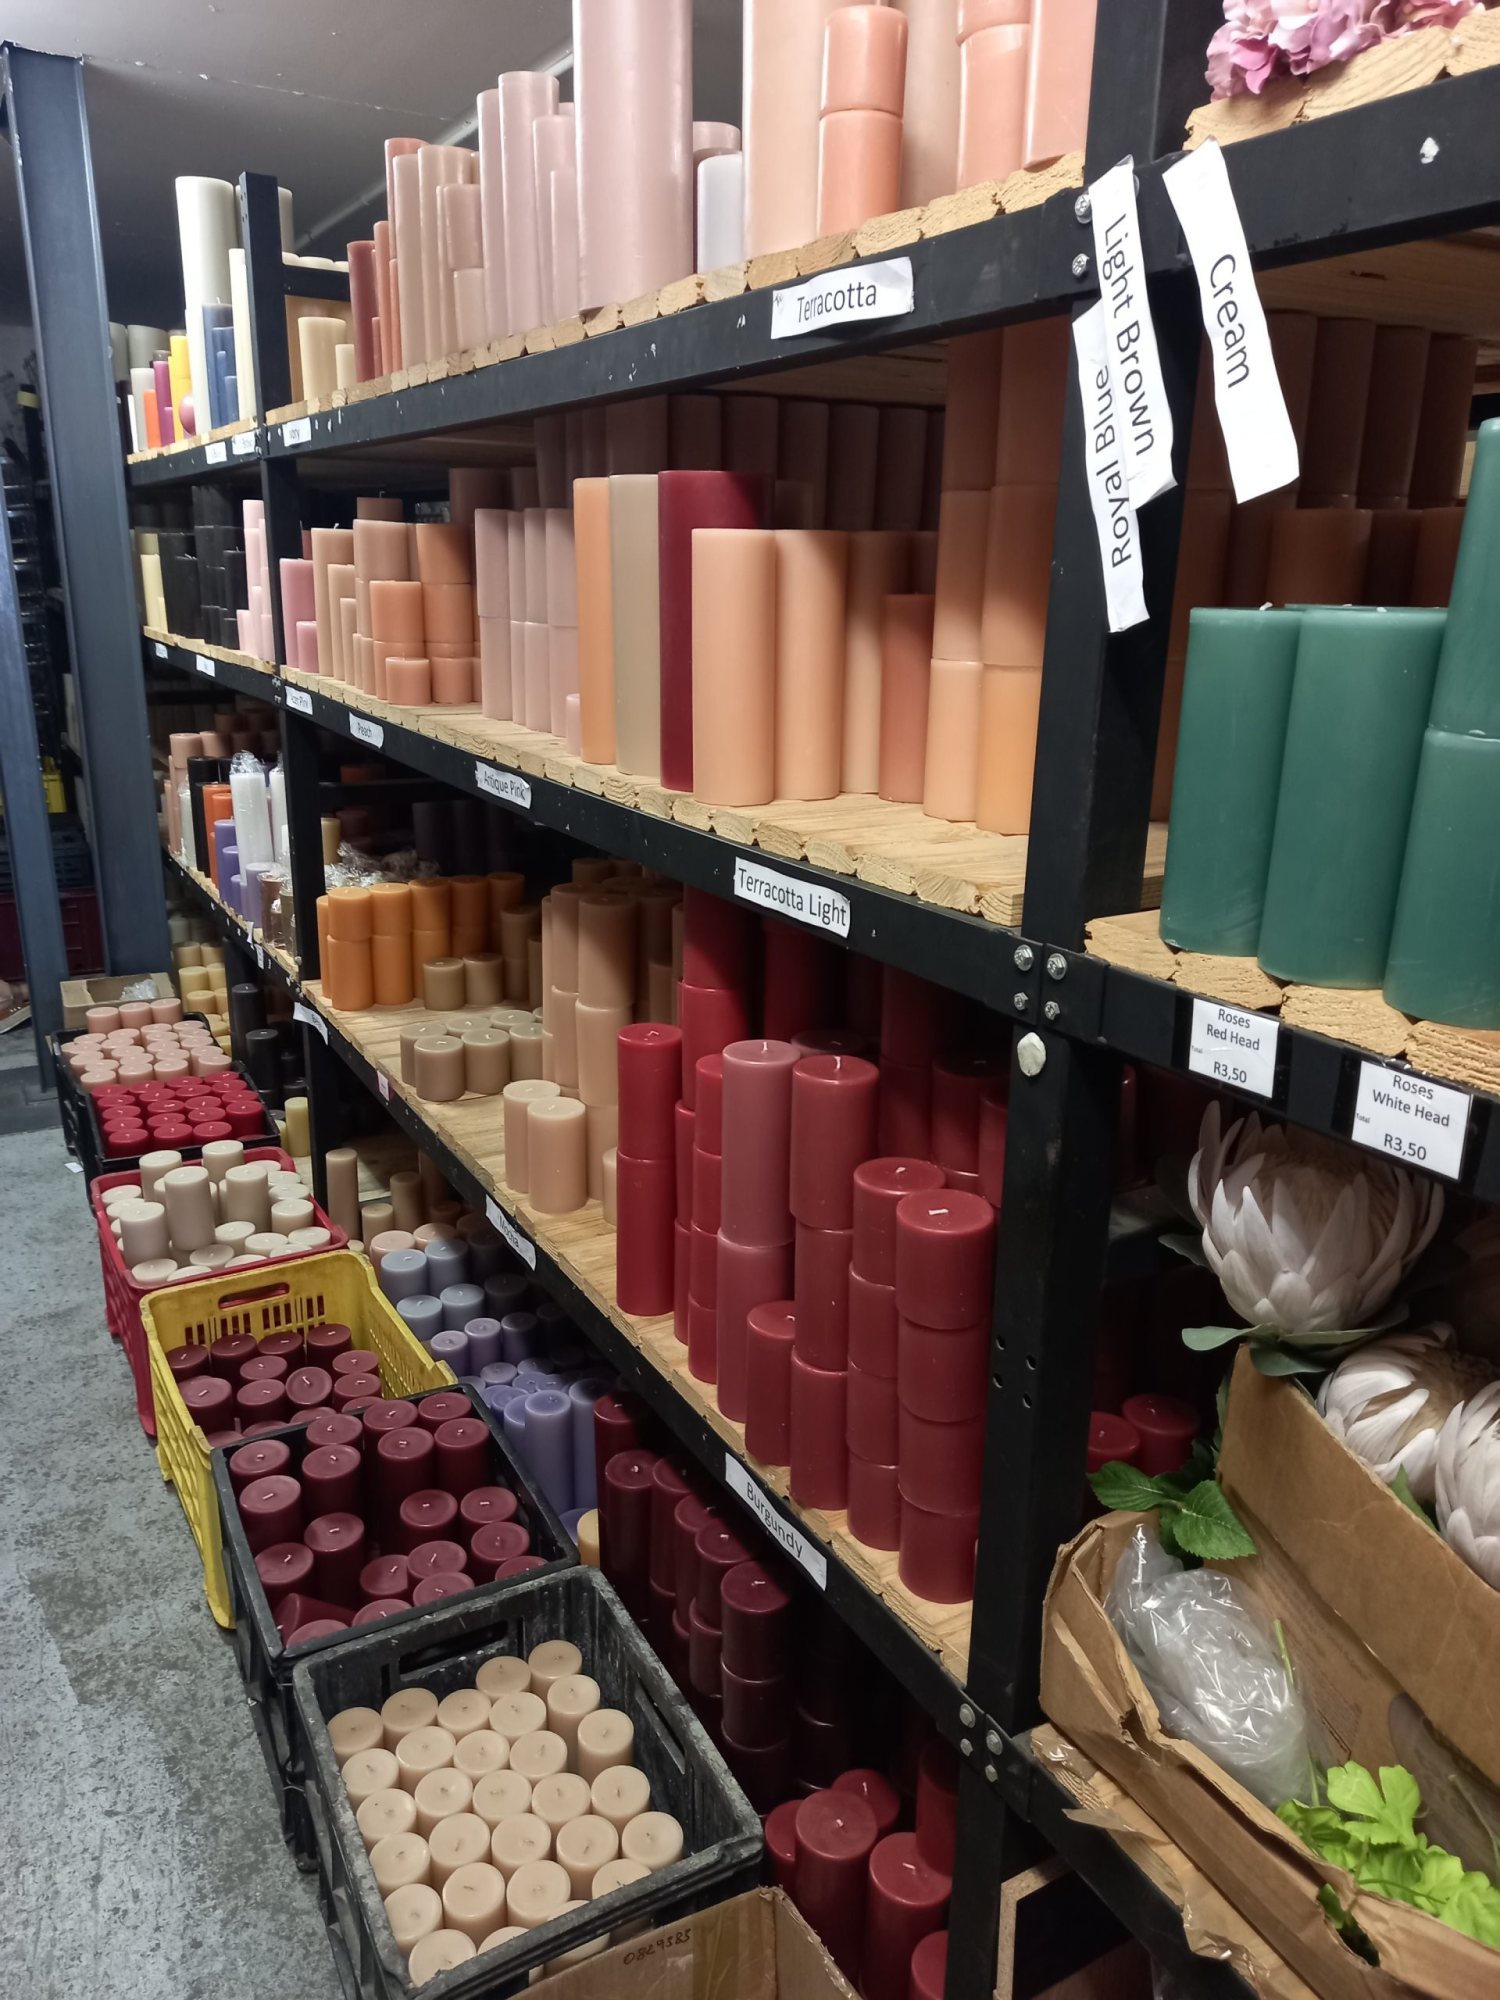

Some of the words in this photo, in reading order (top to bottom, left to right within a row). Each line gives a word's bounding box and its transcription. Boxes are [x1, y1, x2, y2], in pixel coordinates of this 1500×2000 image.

[1102, 213, 1134, 319] Light
[797, 281, 877, 324] Terracotta
[1210, 254, 1250, 389] Cream
[1116, 320, 1155, 456] Brown
[1093, 364, 1116, 454] Blue
[1095, 459, 1133, 568] Royal
[510, 780, 526, 801] Pink
[738, 867, 804, 912] Terracotta
[809, 893, 847, 926] Light
[1206, 1024, 1228, 1041] Red
[1230, 1031, 1261, 1051] Head
[1218, 1008, 1251, 1029] Roses
[1213, 1061, 1247, 1083] R3,50
[1392, 1074, 1434, 1100] Roses
[1356, 1113, 1370, 1124] Total
[1373, 1089, 1411, 1114] White
[1415, 1104, 1450, 1127] Head
[1384, 1133, 1427, 1161] R3,50
[747, 1482, 803, 1558] Burgundy
